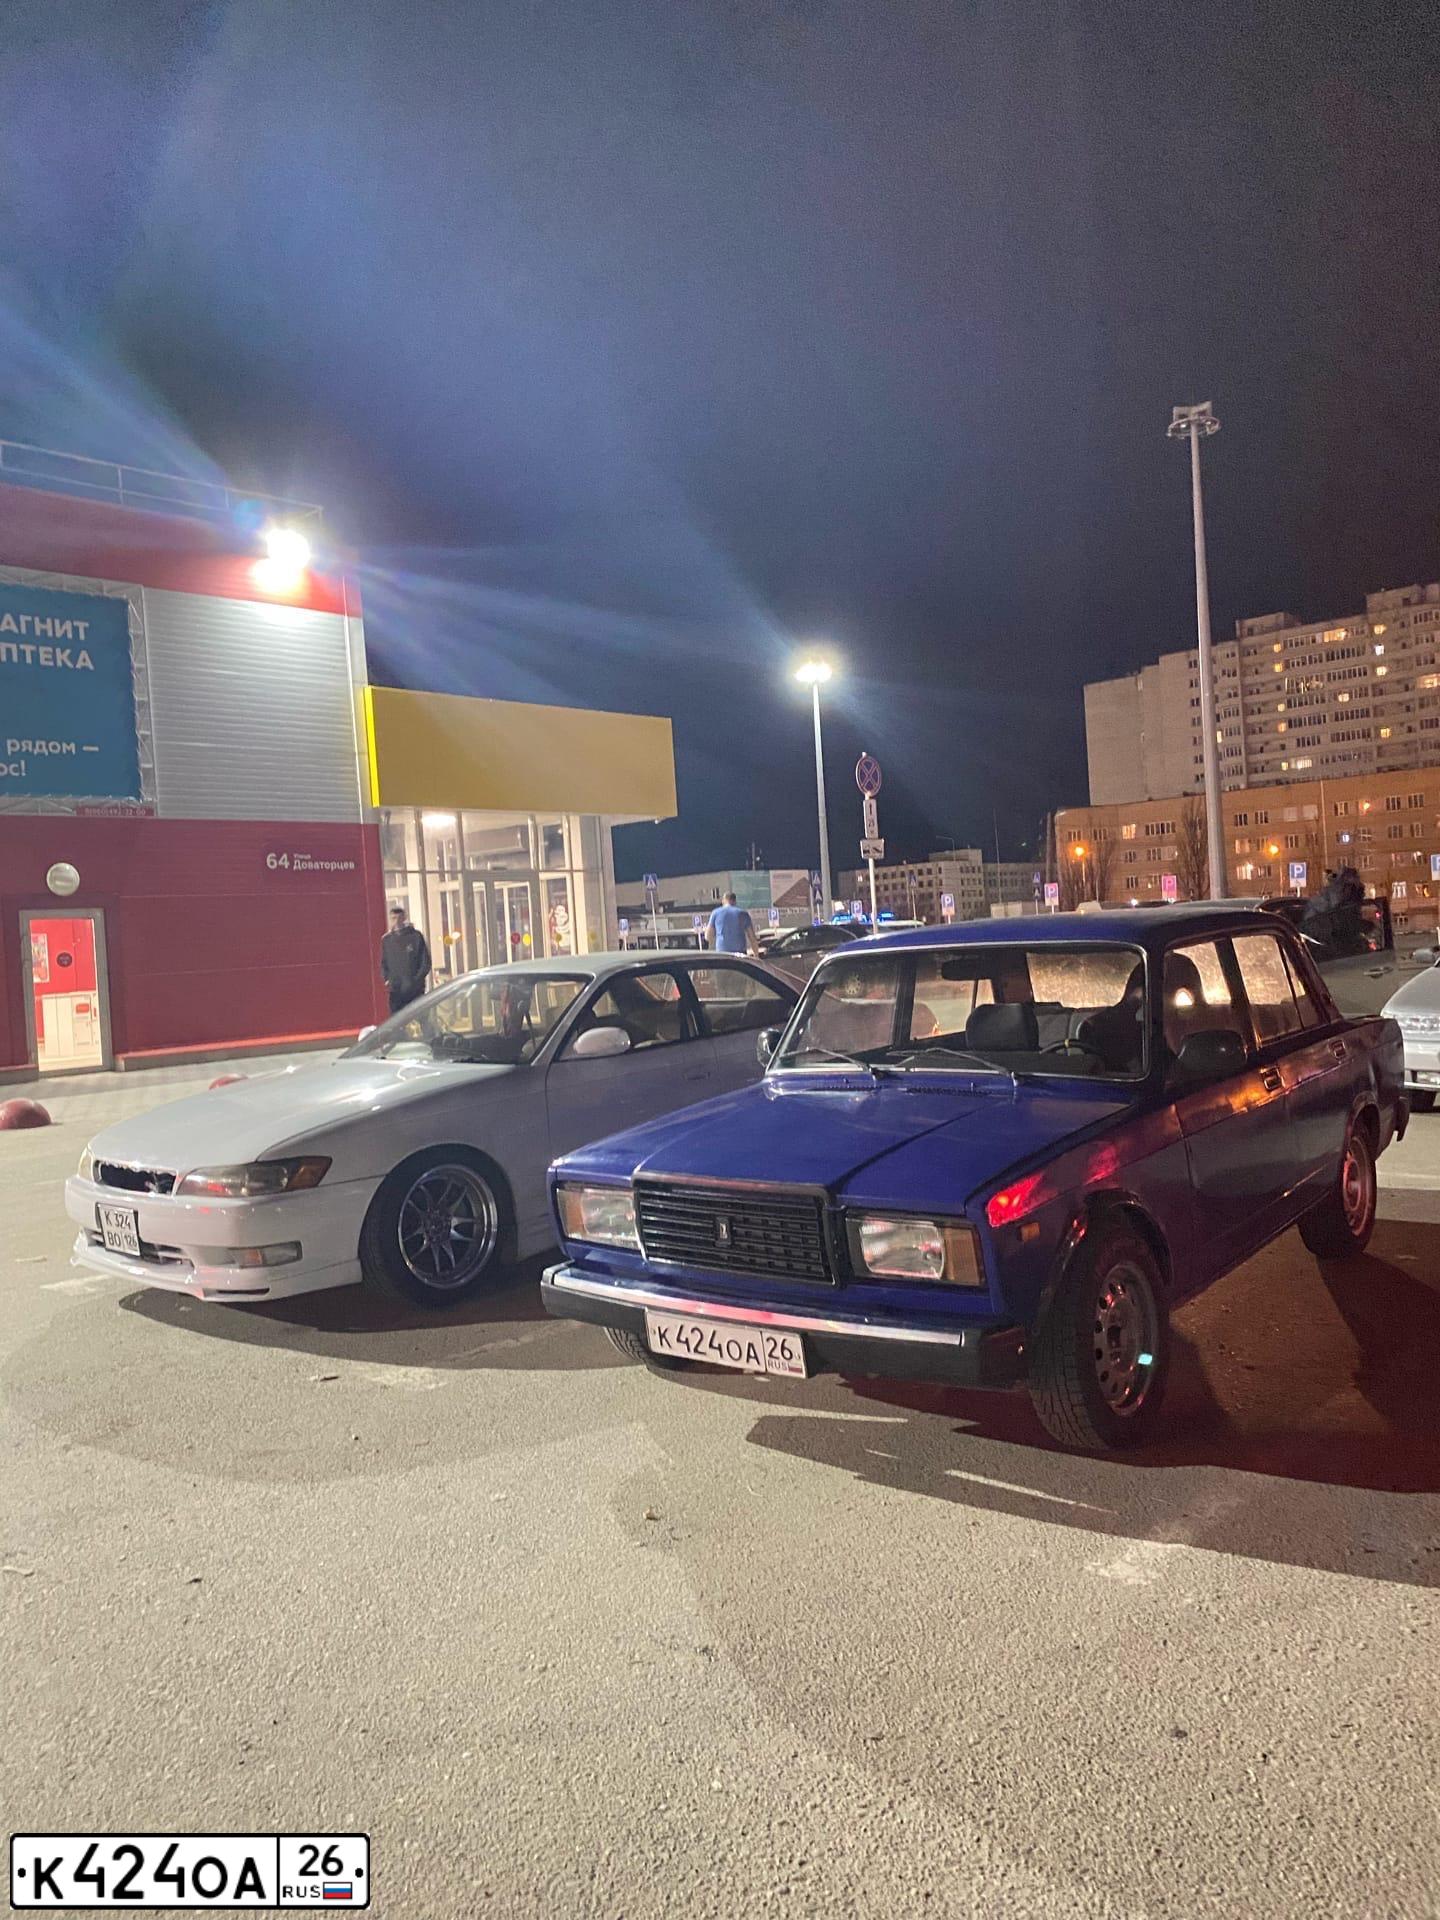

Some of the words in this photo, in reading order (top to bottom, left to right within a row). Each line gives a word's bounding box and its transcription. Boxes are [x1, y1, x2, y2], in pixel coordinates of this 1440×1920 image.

[6, 738, 76, 756] рядом
[266, 852, 290, 870] 64
[293, 860, 355, 872] Доваторцев
[657, 1324, 761, 1365] К424ОА
[766, 1336, 794, 1361] 26
[767, 1359, 789, 1371] RUS
